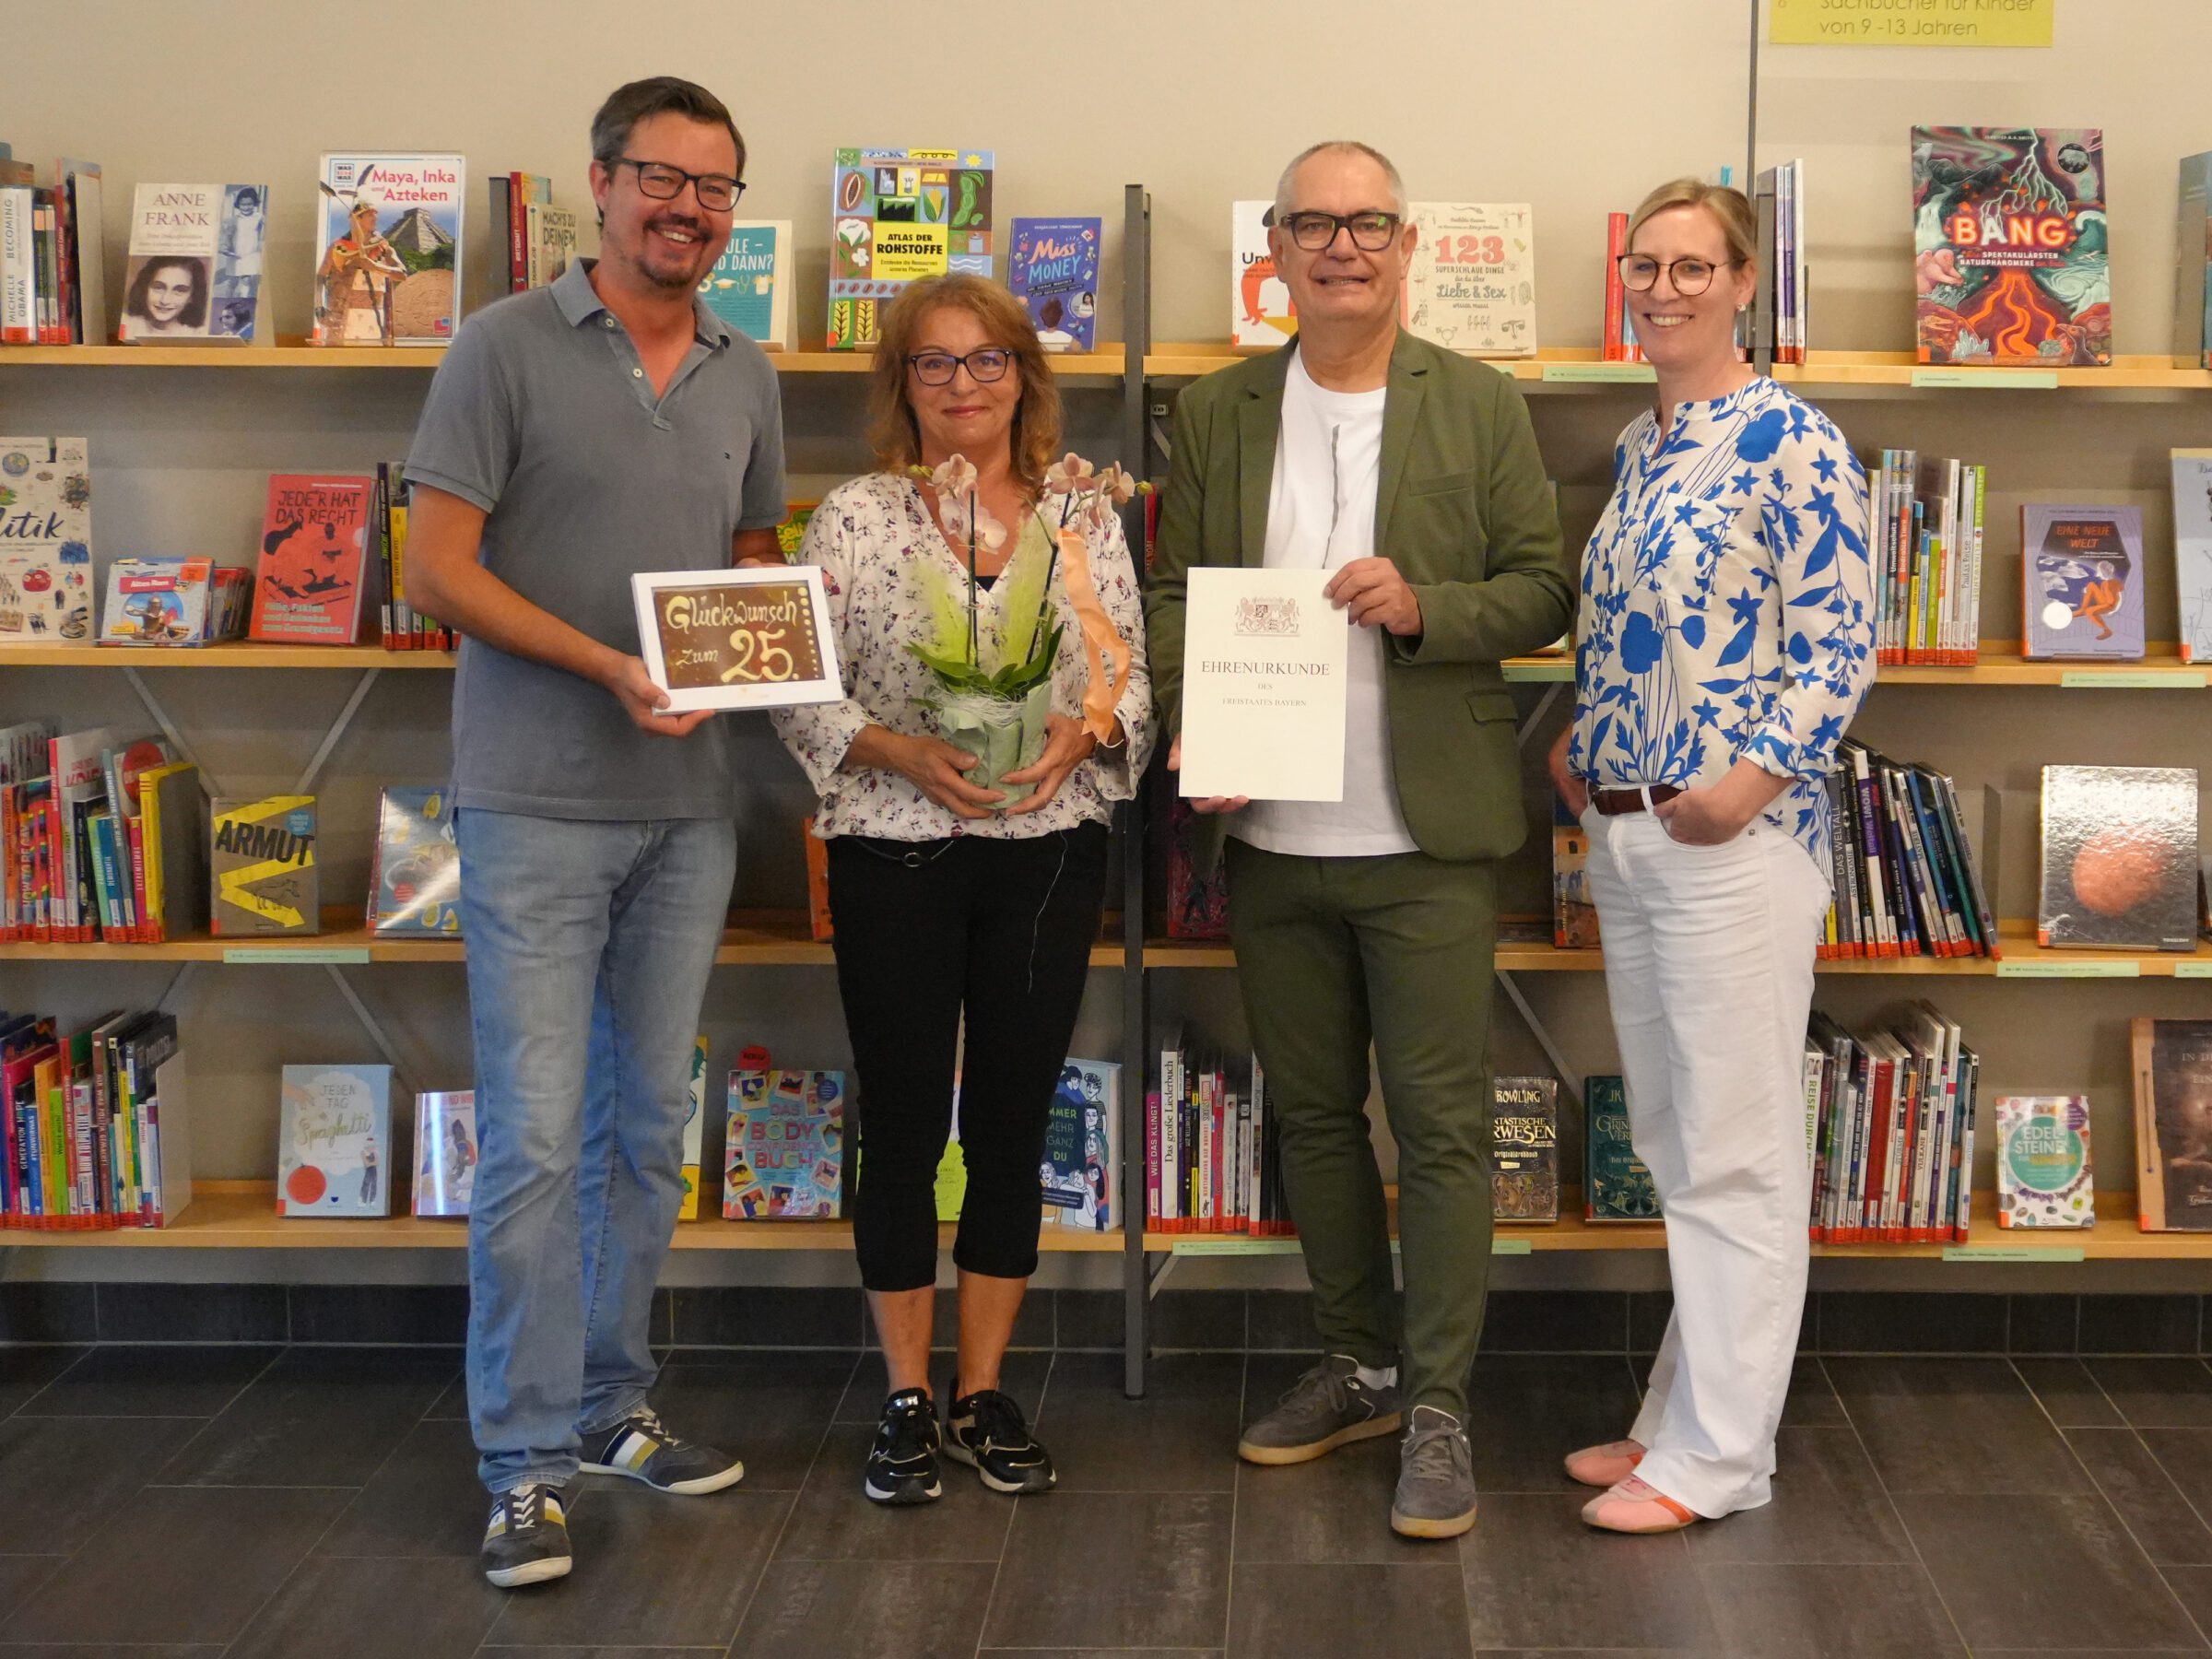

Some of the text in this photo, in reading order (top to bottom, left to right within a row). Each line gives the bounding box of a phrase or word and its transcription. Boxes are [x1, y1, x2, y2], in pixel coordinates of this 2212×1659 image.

[1819, 21, 1854, 34] von
[1861, 18, 1872, 34] 9
[1912, 18, 1978, 36] Jahren
[372, 169, 456, 187] Maya, Inka
[153, 193, 206, 206] ANNE
[383, 186, 448, 201] Azteken
[145, 211, 210, 226] FRANK
[5, 198, 15, 259] BECOMING
[888, 233, 913, 241] ATLAS
[1953, 215, 2068, 246] BANG
[877, 243, 943, 254] ROHSTOFFE
[1028, 237, 1076, 265] Miss
[1435, 235, 1505, 265] 123
[732, 253, 773, 271] DANN?
[1029, 254, 1082, 284] MONEY
[1435, 265, 1483, 274] SUPERSCHLAUE
[7, 274, 16, 323] MICHELLE
[18, 279, 26, 317] OBAMA
[1436, 282, 1472, 298] Liebe
[1483, 285, 1508, 299] Sex
[331, 491, 361, 507] HAT
[276, 508, 358, 525] DAS RECHT
[2056, 525, 2110, 535] EINE NEUE
[1889, 523, 1898, 572] Umweltschutz
[2070, 538, 2100, 548] WELT
[665, 590, 798, 634] Glückwunsch
[1201, 660, 1330, 677] EHRENURKUNDE
[1257, 682, 1274, 690] DES
[1222, 698, 1307, 707] FREISTAATES BAYERN
[1862, 787, 1873, 818] WOW!
[215, 819, 315, 866] ARMUT
[1832, 805, 1845, 876] DAS WELTALL
[21, 864, 31, 879] TO
[133, 846, 144, 890] EXTREMISMUS
[1847, 849, 1857, 899] ASTRONOMIE
[22, 882, 32, 907] HOW
[320, 1084, 356, 1096] JEDEN
[1495, 1088, 1542, 1104] ROWLING
[1807, 1080, 1818, 1111] REISE
[327, 1097, 349, 1109] TAG
[770, 1103, 800, 1115] DAS
[1164, 1061, 1176, 1163] Das große Liederbuch
[298, 1112, 371, 1150] Spaghetti
[750, 1120, 817, 1141] BODY
[1150, 1101, 1159, 1177] WIE DAS KLINGT!
[18, 1126, 28, 1170] GENERATION
[76, 1114, 91, 1172] HOW TO POLITIK
[1046, 1135, 1075, 1148] GANZ
[2015, 1140, 2067, 1154] STEINE
[754, 1150, 815, 1169] BUCH
[1053, 1151, 1068, 1162] DU
